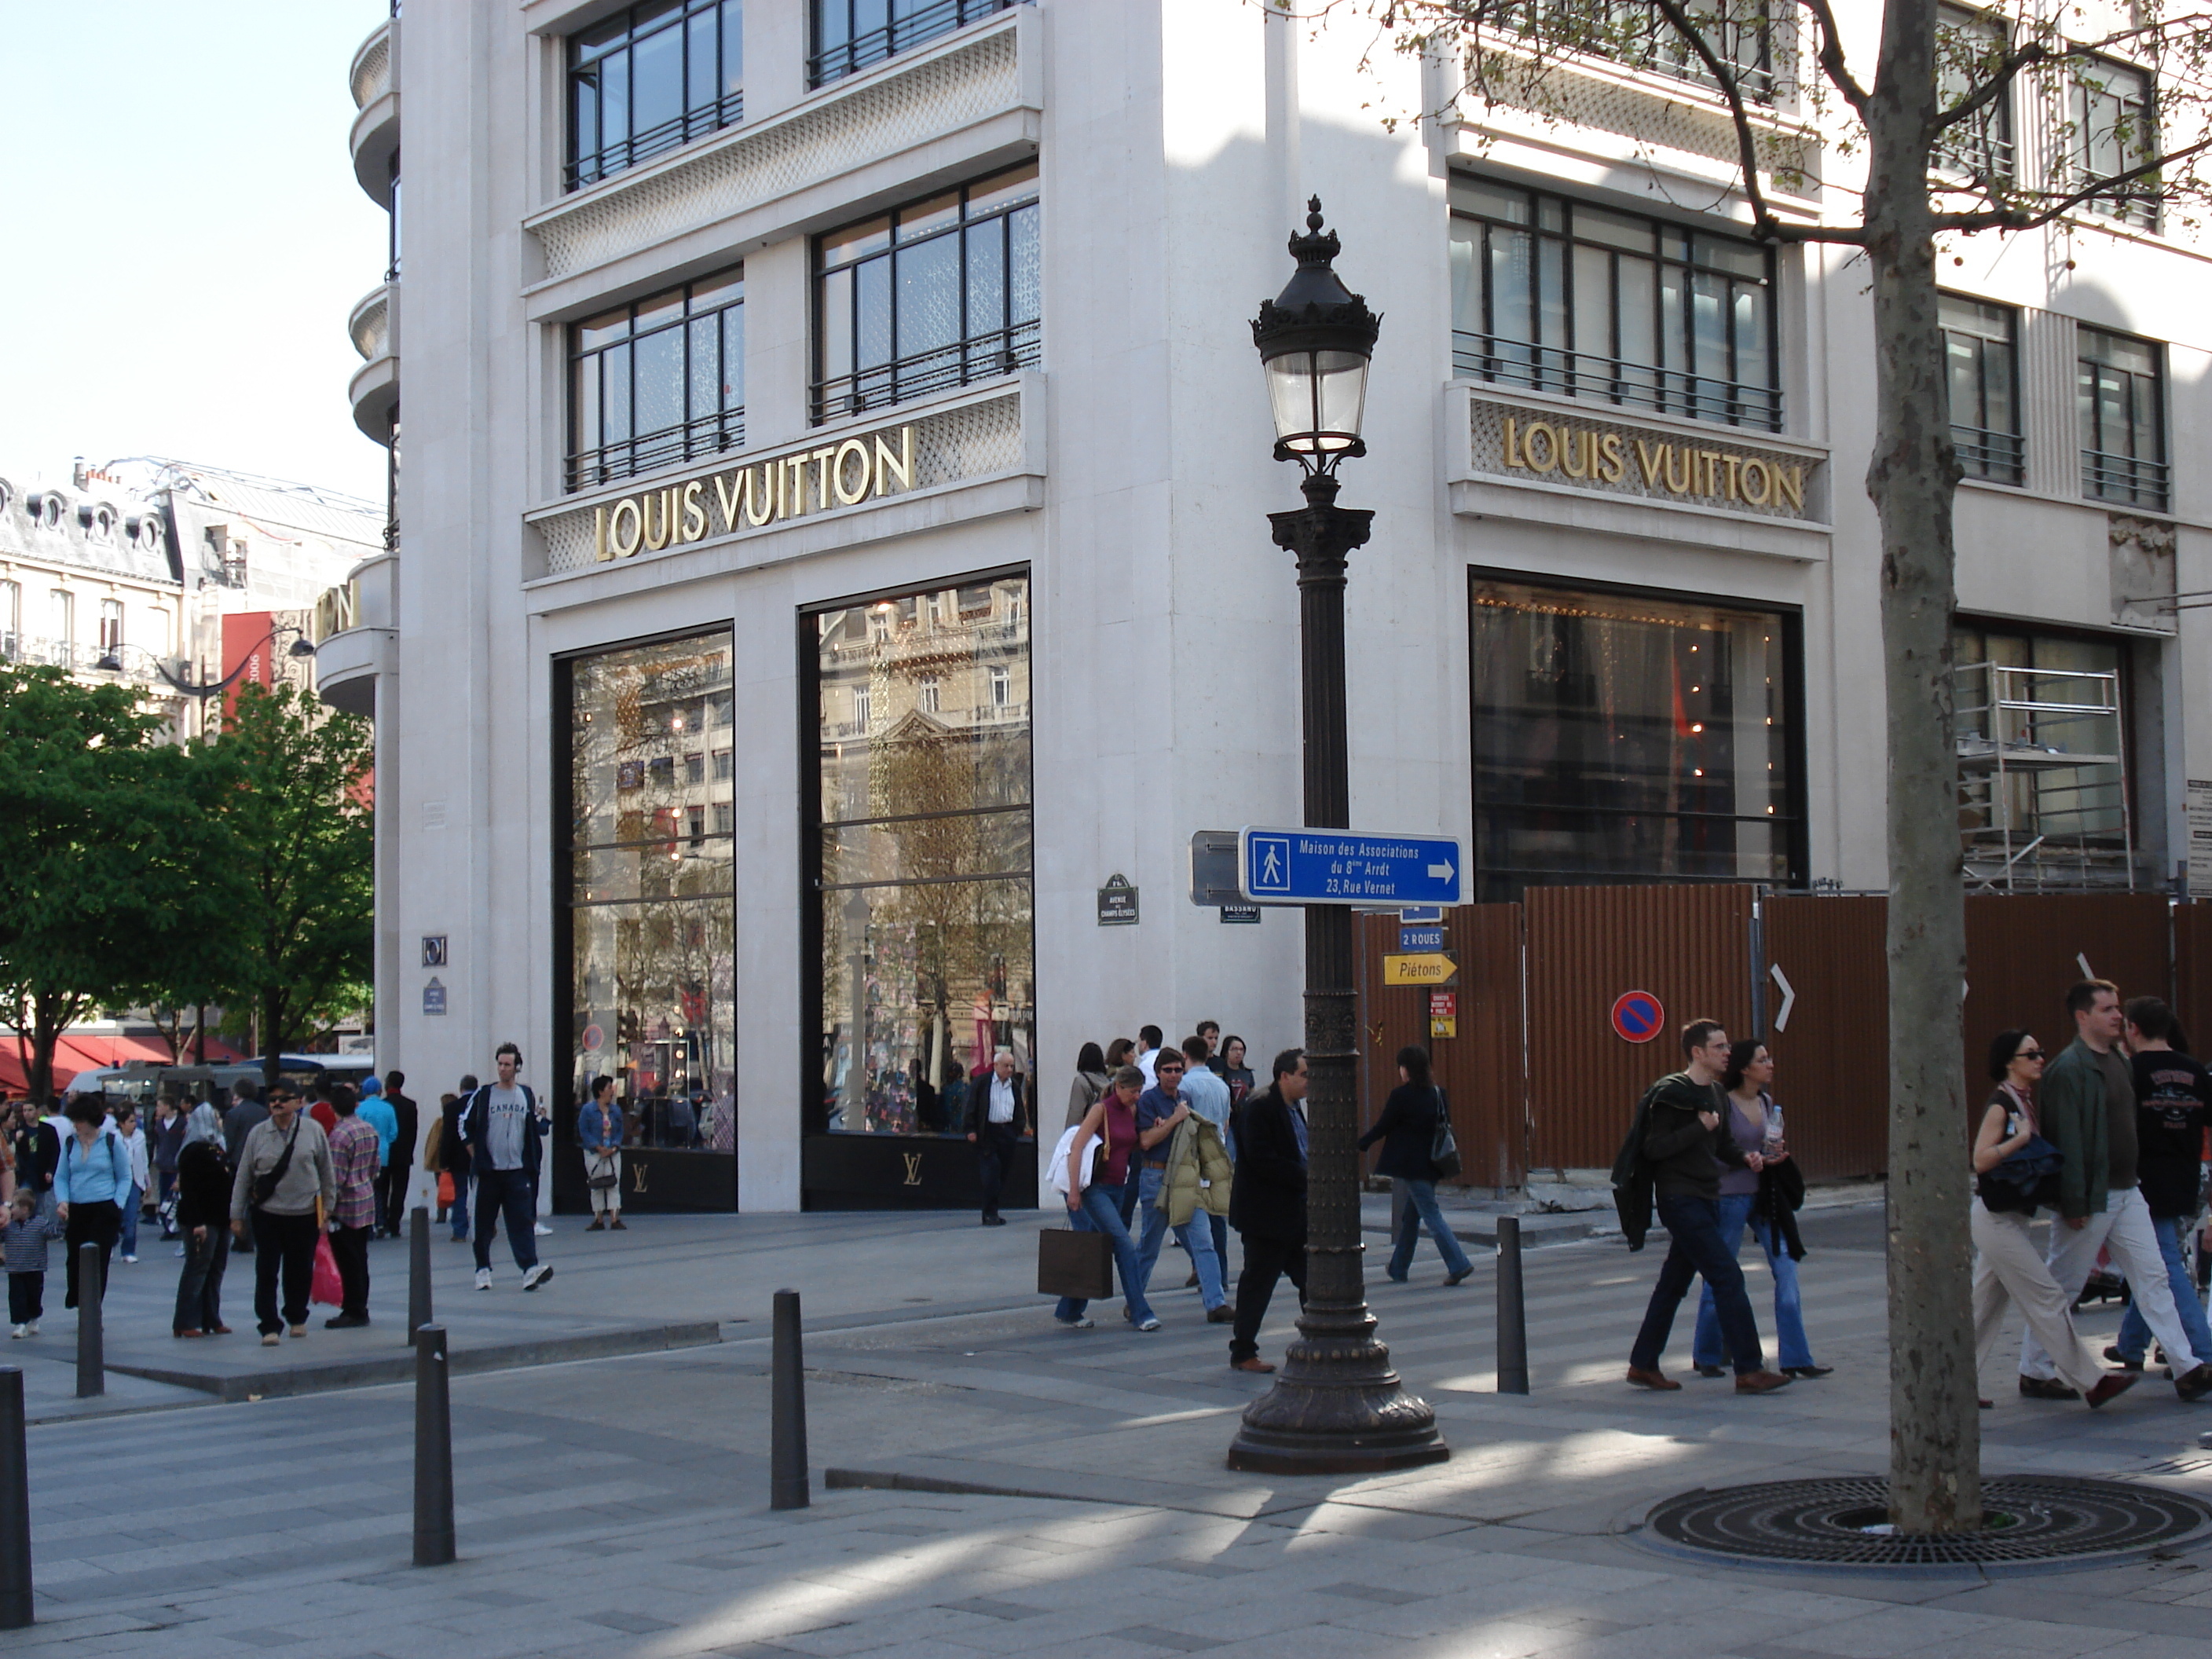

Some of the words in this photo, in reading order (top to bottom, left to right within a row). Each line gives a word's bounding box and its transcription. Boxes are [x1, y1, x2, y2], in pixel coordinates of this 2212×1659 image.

[1503, 418, 1624, 483] LOUIS
[1632, 440, 1801, 511] VUITTON
[595, 481, 708, 562] LOUIS
[714, 426, 915, 533] VUITTON
[1299, 839, 1335, 855] Maison
[1338, 841, 1354, 856] des
[1358, 842, 1419, 859] Associations
[1331, 860, 1342, 874] du
[1364, 861, 1390, 877] Arrdt
[1342, 879, 1361, 894] Rue
[1364, 880, 1395, 895] Vernet
[1403, 935, 1409, 946] 2
[1412, 933, 1441, 945] ROUES
[1400, 962, 1441, 977] Piétons
[490, 1104, 525, 1114] CANADA
